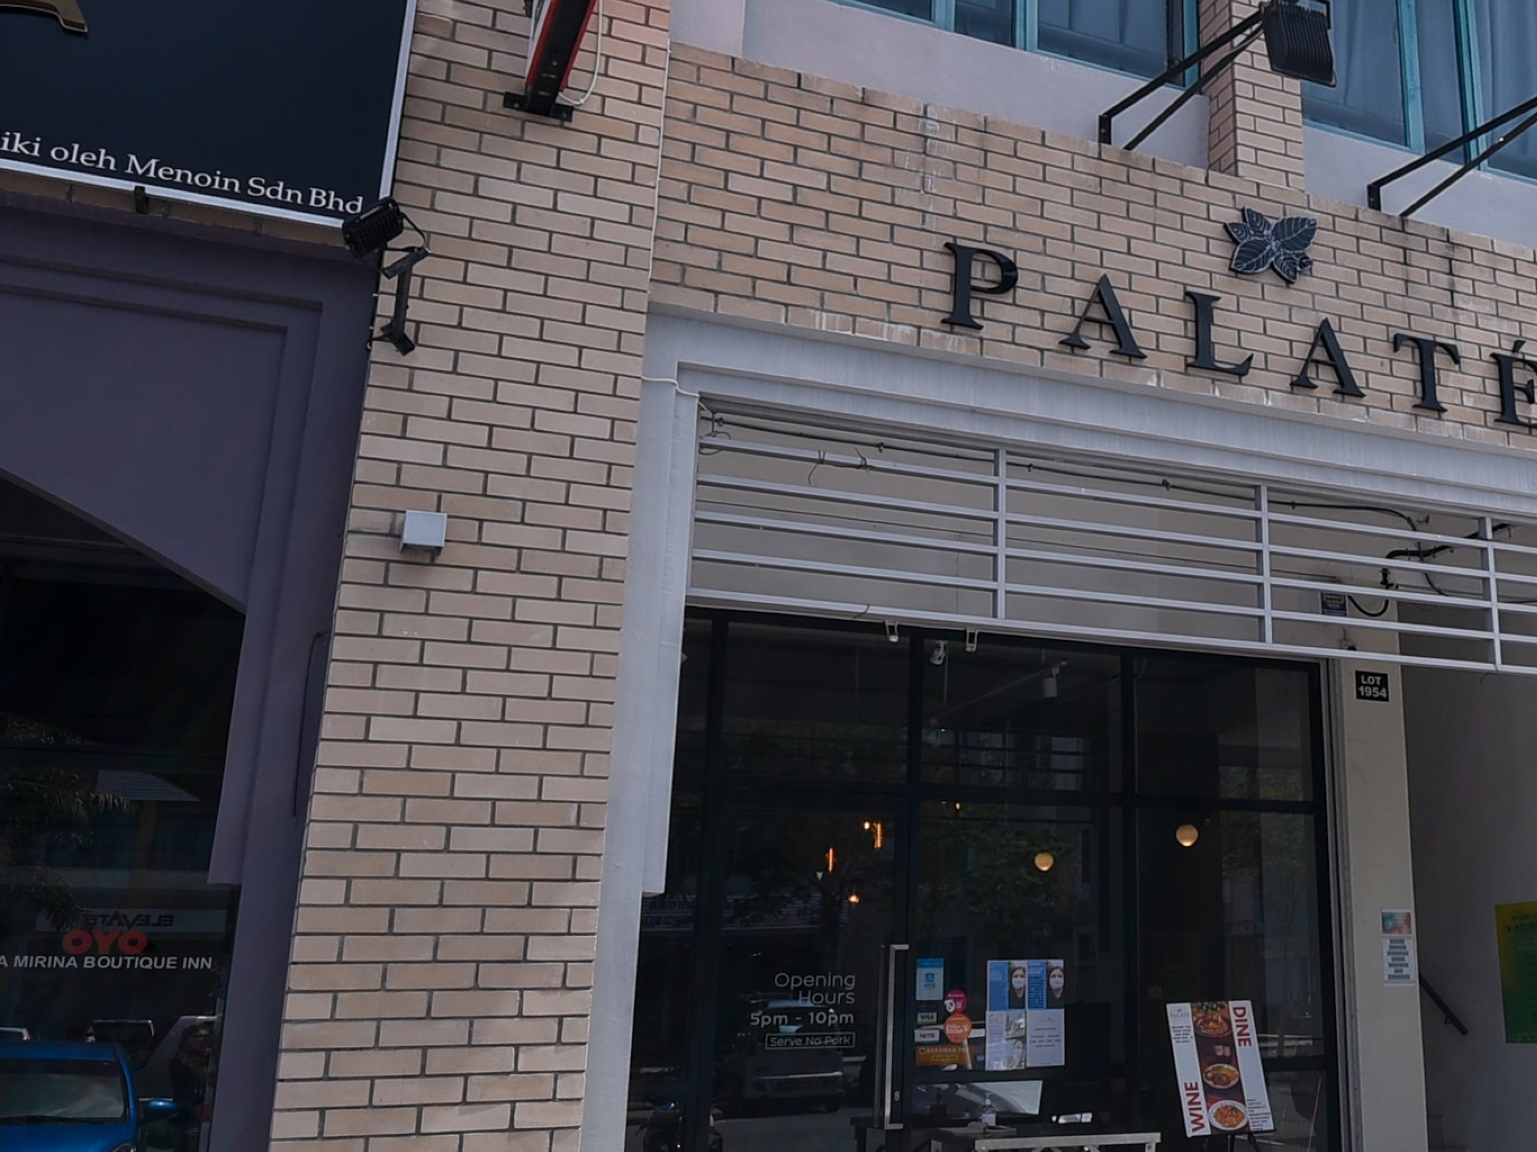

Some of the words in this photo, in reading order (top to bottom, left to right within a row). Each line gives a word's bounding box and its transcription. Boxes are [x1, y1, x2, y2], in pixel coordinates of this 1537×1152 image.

[50, 143, 117, 171] oleh
[124, 154, 241, 194] Menoin
[247, 176, 304, 205] Sdn
[308, 187, 364, 215] Bhd
[1360, 674, 1382, 686] LOT
[1358, 685, 1387, 698] 1954
[62, 929, 148, 955] OYO
[13, 955, 78, 969] MIRINA
[83, 955, 177, 970] BOUTIQUE
[182, 956, 212, 970] INN
[774, 972, 856, 990] Opening
[798, 990, 856, 1005] Hours
[750, 1012, 788, 1027] 5pm
[808, 1011, 855, 1026] 10pm
[1233, 1006, 1252, 1047] DINE
[770, 1036, 802, 1047] Serve
[805, 1036, 821, 1046] No
[824, 1035, 852, 1046] Pork
[1184, 1081, 1206, 1133] WINE
